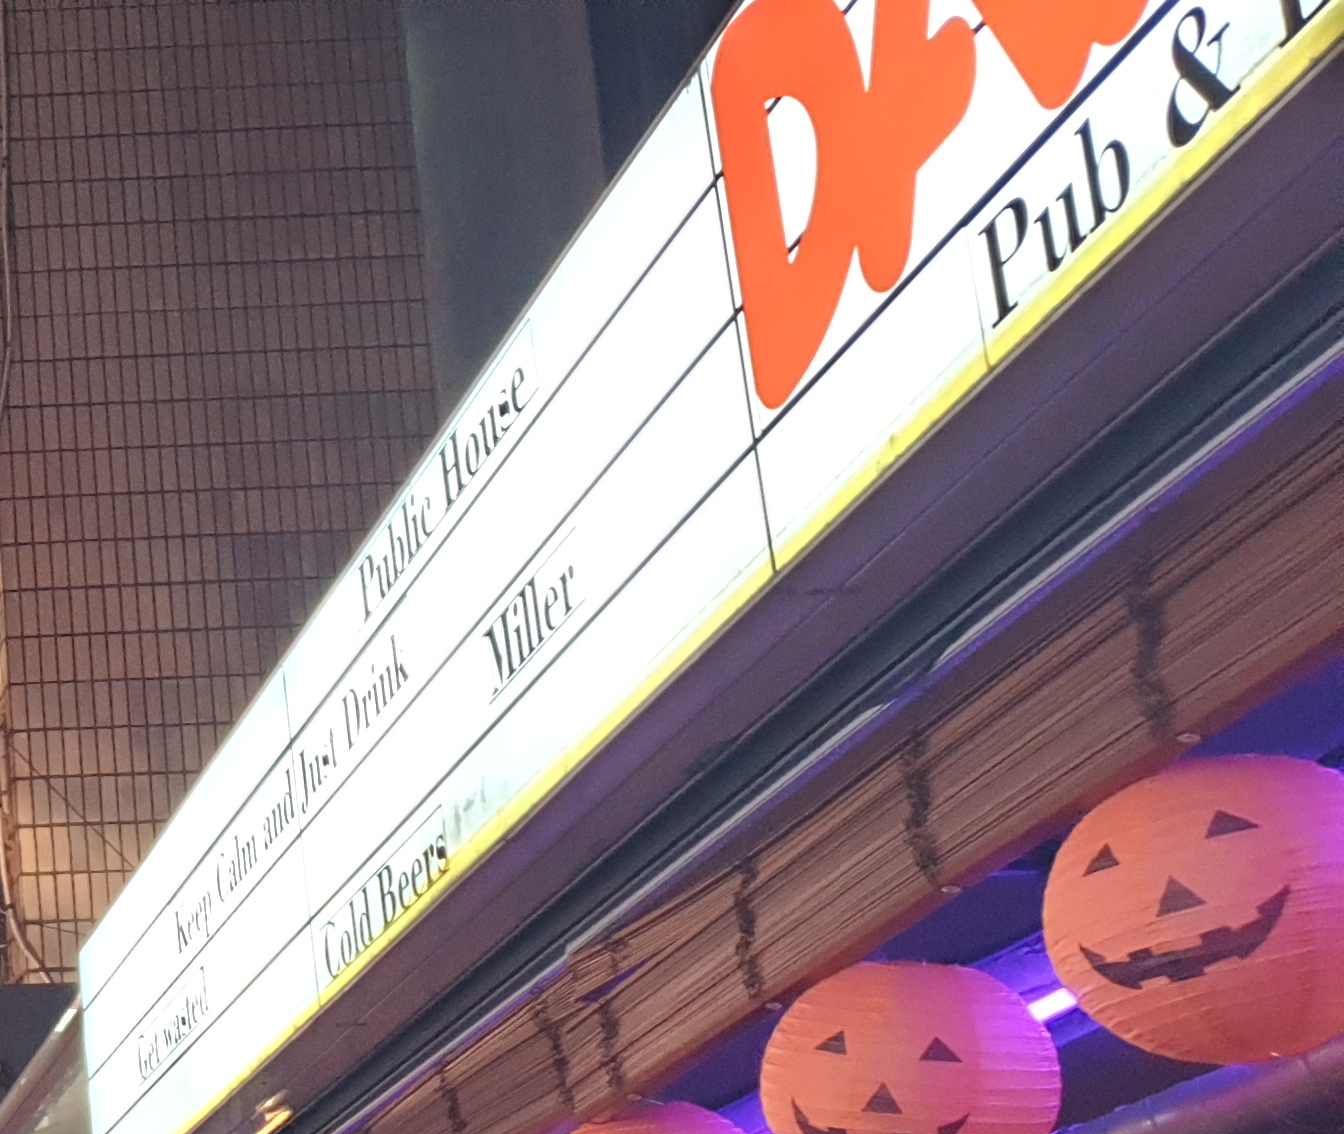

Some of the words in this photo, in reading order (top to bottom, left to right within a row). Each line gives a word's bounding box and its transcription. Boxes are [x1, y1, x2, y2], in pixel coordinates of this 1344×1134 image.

[979, 118, 1131, 328] Pub
[1167, 5, 1242, 148] &
[357, 494, 432, 624] Public
[438, 366, 526, 507] House
[482, 564, 575, 697] Miller
[262, 769, 296, 854] and
[341, 634, 410, 751] Drink
[322, 886, 373, 980] Cold
[377, 831, 450, 928] Beers
